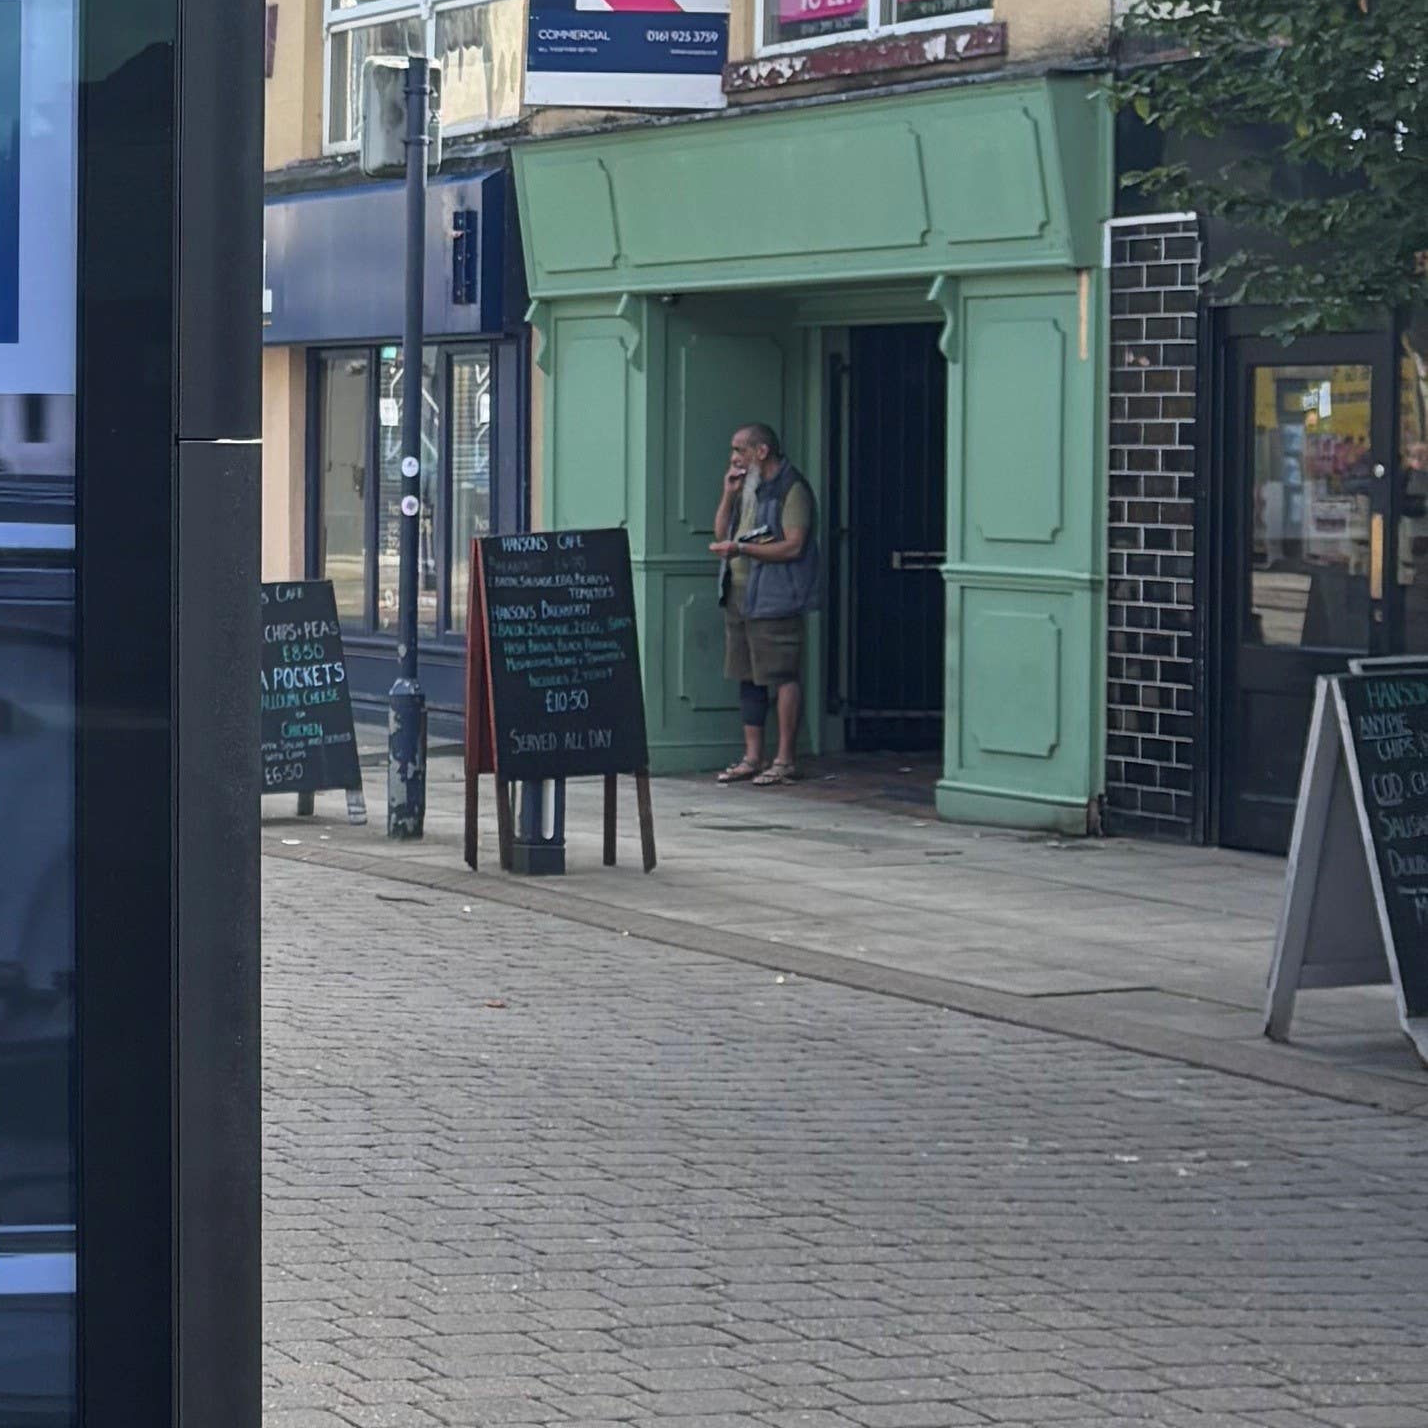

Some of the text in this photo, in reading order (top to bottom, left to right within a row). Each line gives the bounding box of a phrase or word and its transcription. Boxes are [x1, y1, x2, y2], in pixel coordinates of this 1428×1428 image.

[538, 29, 610, 41] COMMERCIAL
[647, 30, 718, 43] 0161 925 3759
[273, 662, 345, 690] POCKETS
[509, 729, 612, 754] SERVED ALL DAY
